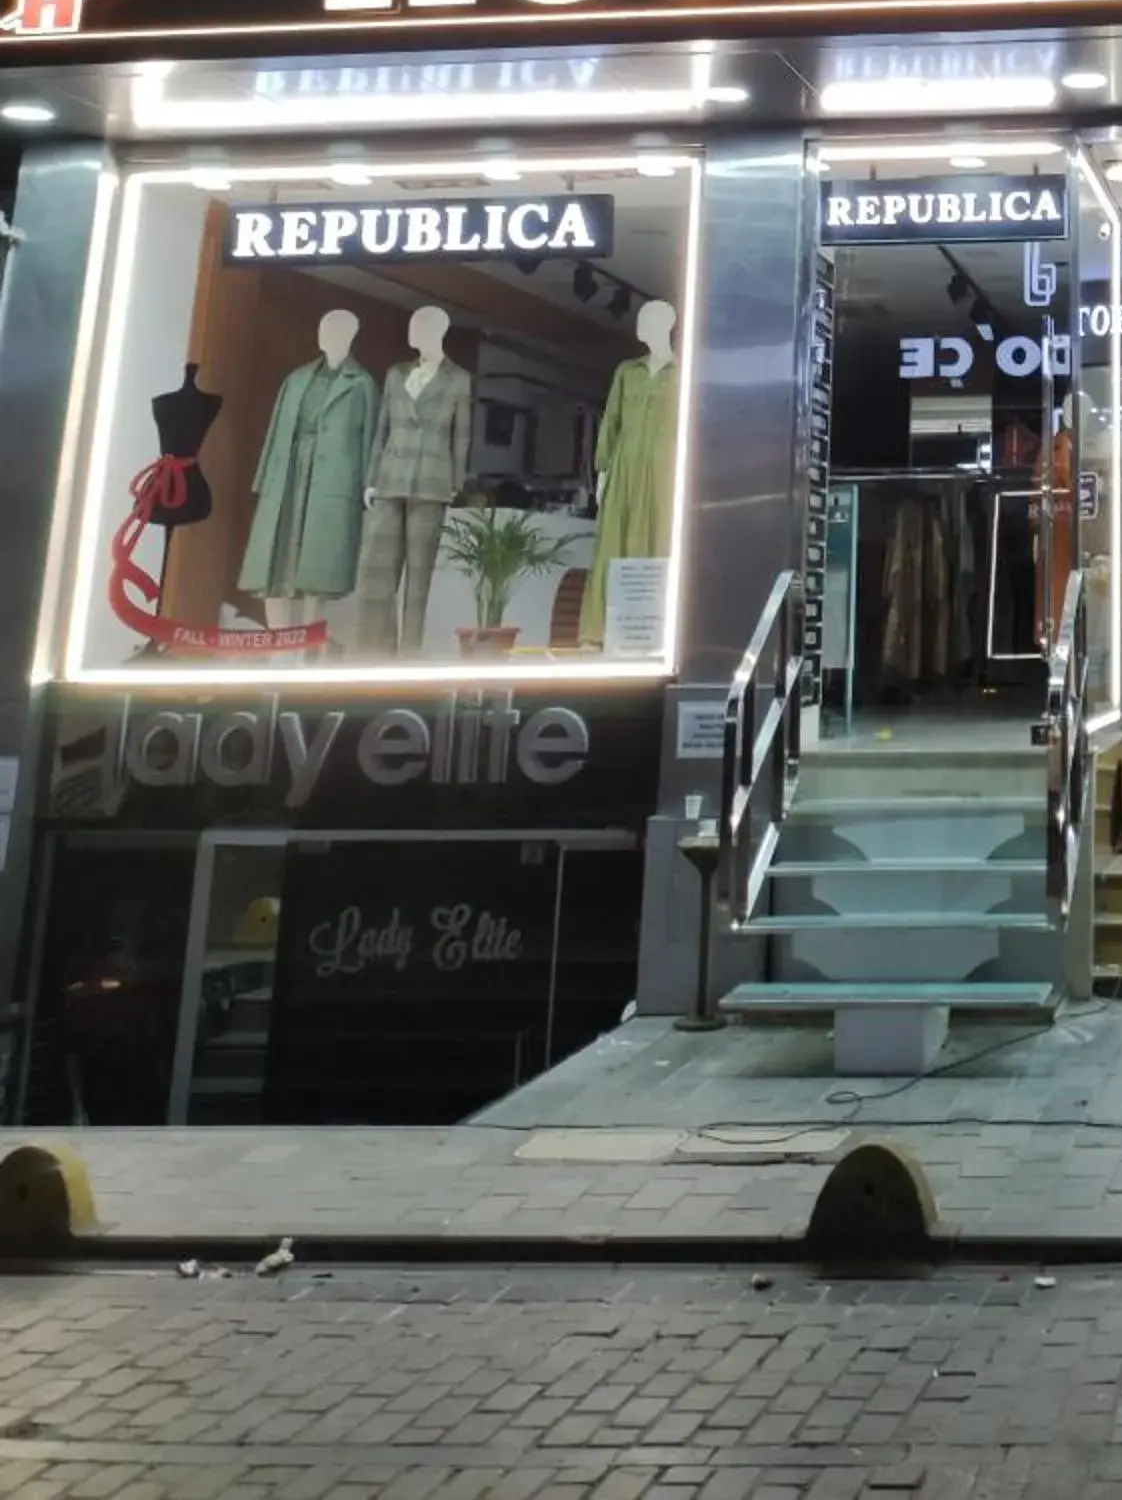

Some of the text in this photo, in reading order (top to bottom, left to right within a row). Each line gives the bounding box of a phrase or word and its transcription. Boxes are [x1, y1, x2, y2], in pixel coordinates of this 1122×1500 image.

[232, 202, 596, 258] REPUBLICA
[826, 190, 1062, 228] REPUBLICA
[357, 689, 590, 785] elite
[308, 905, 415, 978] Lady
